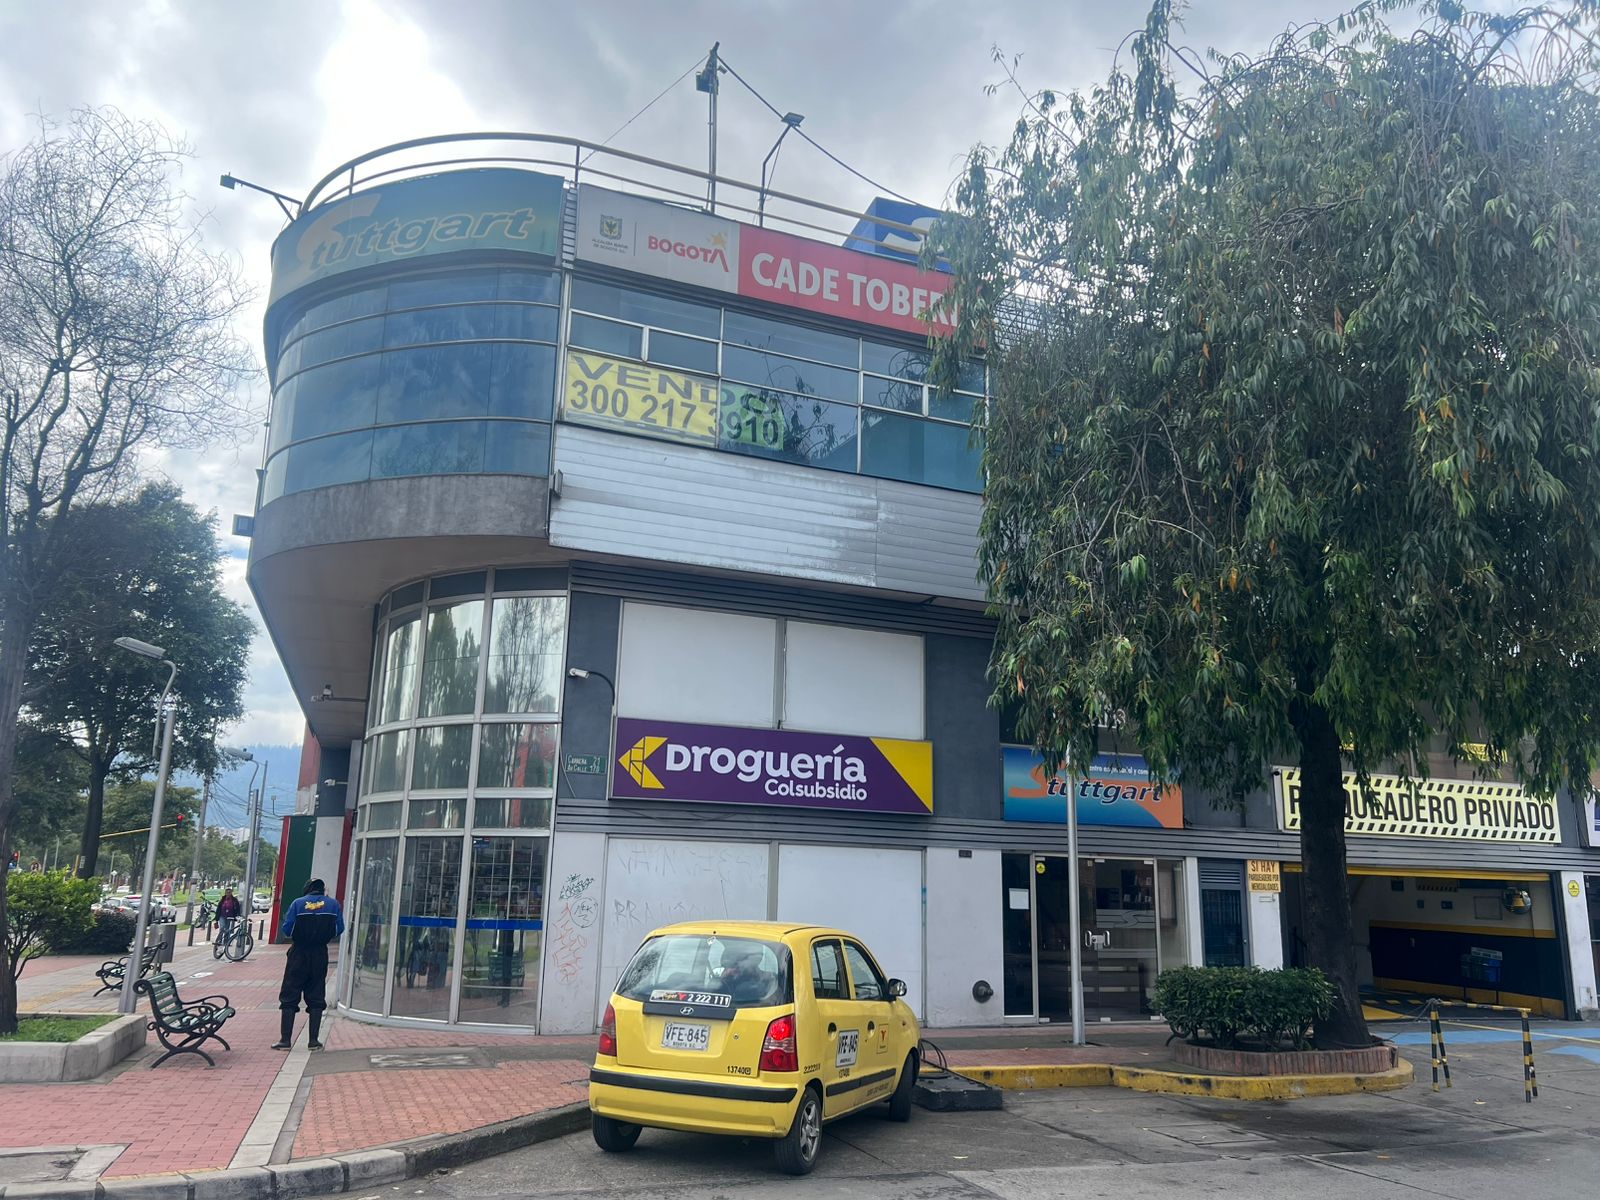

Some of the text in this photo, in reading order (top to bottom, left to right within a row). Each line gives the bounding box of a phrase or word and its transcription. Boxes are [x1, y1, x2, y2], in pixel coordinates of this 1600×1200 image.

[751, 252, 840, 302] CADE
[570, 379, 779, 446] 300 217 3910
[666, 744, 867, 783] Droguería
[765, 779, 868, 801] Colsubsidio
[1289, 785, 1555, 830] PQUEADERO PRIVADO
[1260, 860, 1275, 873] HAY
[688, 994, 694, 1002] 2
[695, 995, 712, 1004] 222
